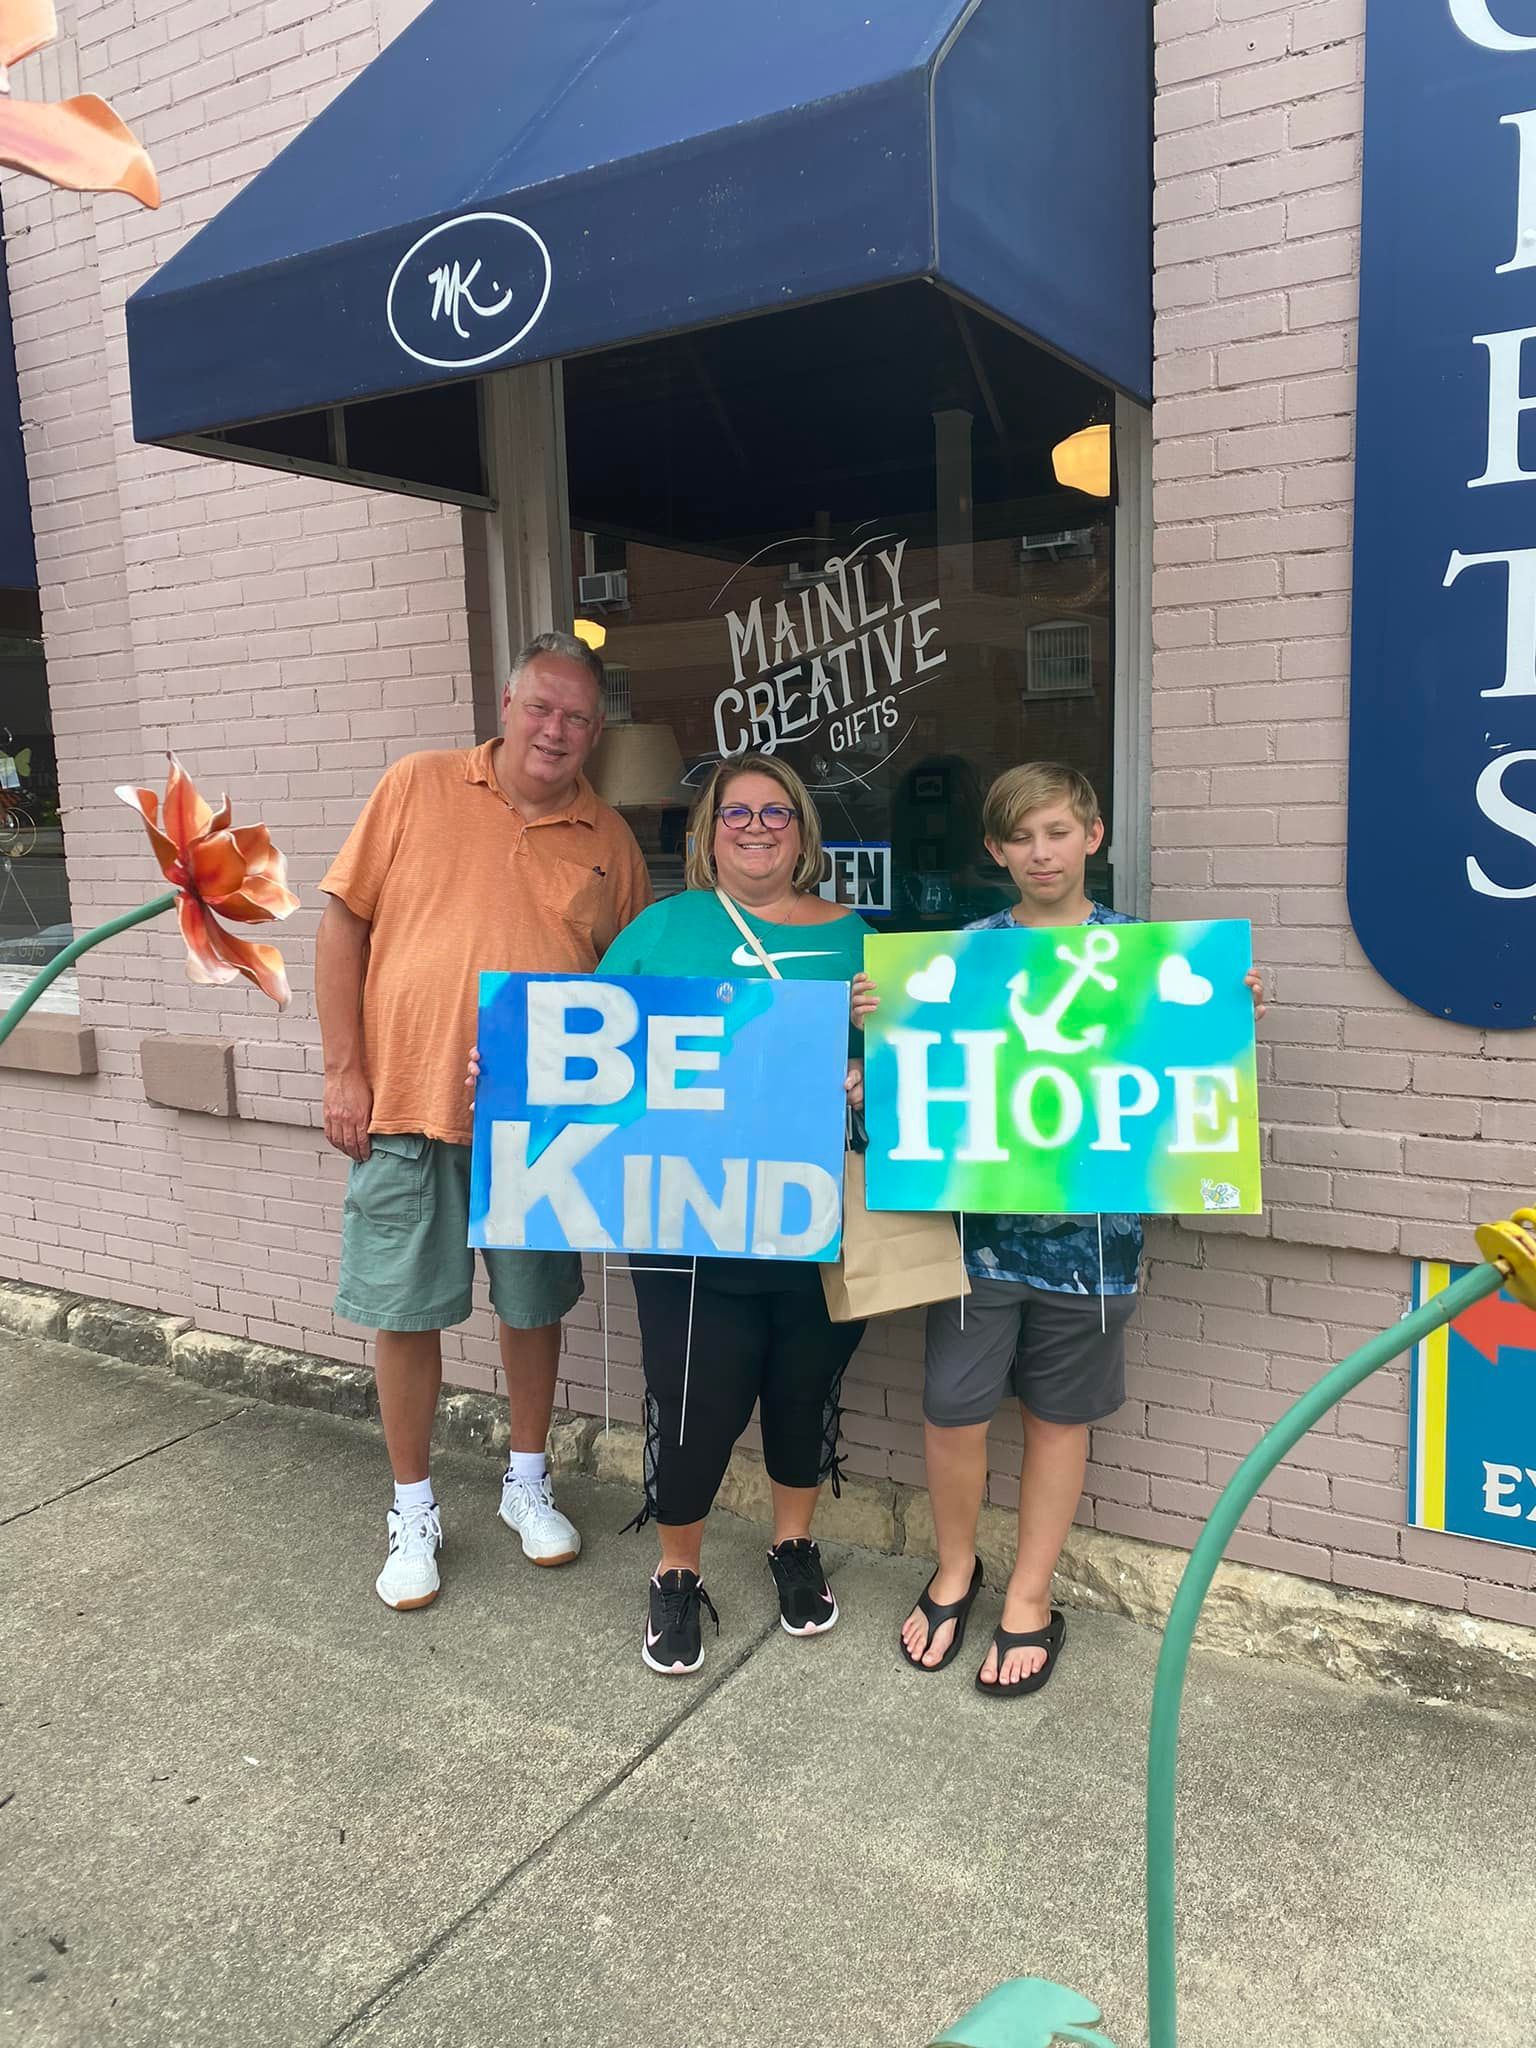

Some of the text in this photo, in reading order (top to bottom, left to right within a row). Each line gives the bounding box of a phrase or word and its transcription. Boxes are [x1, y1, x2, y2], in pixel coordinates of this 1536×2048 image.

[724, 537, 909, 685] MAINLY
[713, 598, 947, 759] CREATIVE
[829, 695, 899, 752] GIFTS
[810, 851, 884, 906] EN
[526, 980, 725, 1110] BE
[884, 1028, 1240, 1161] HOPE
[484, 1120, 840, 1257] KIND
